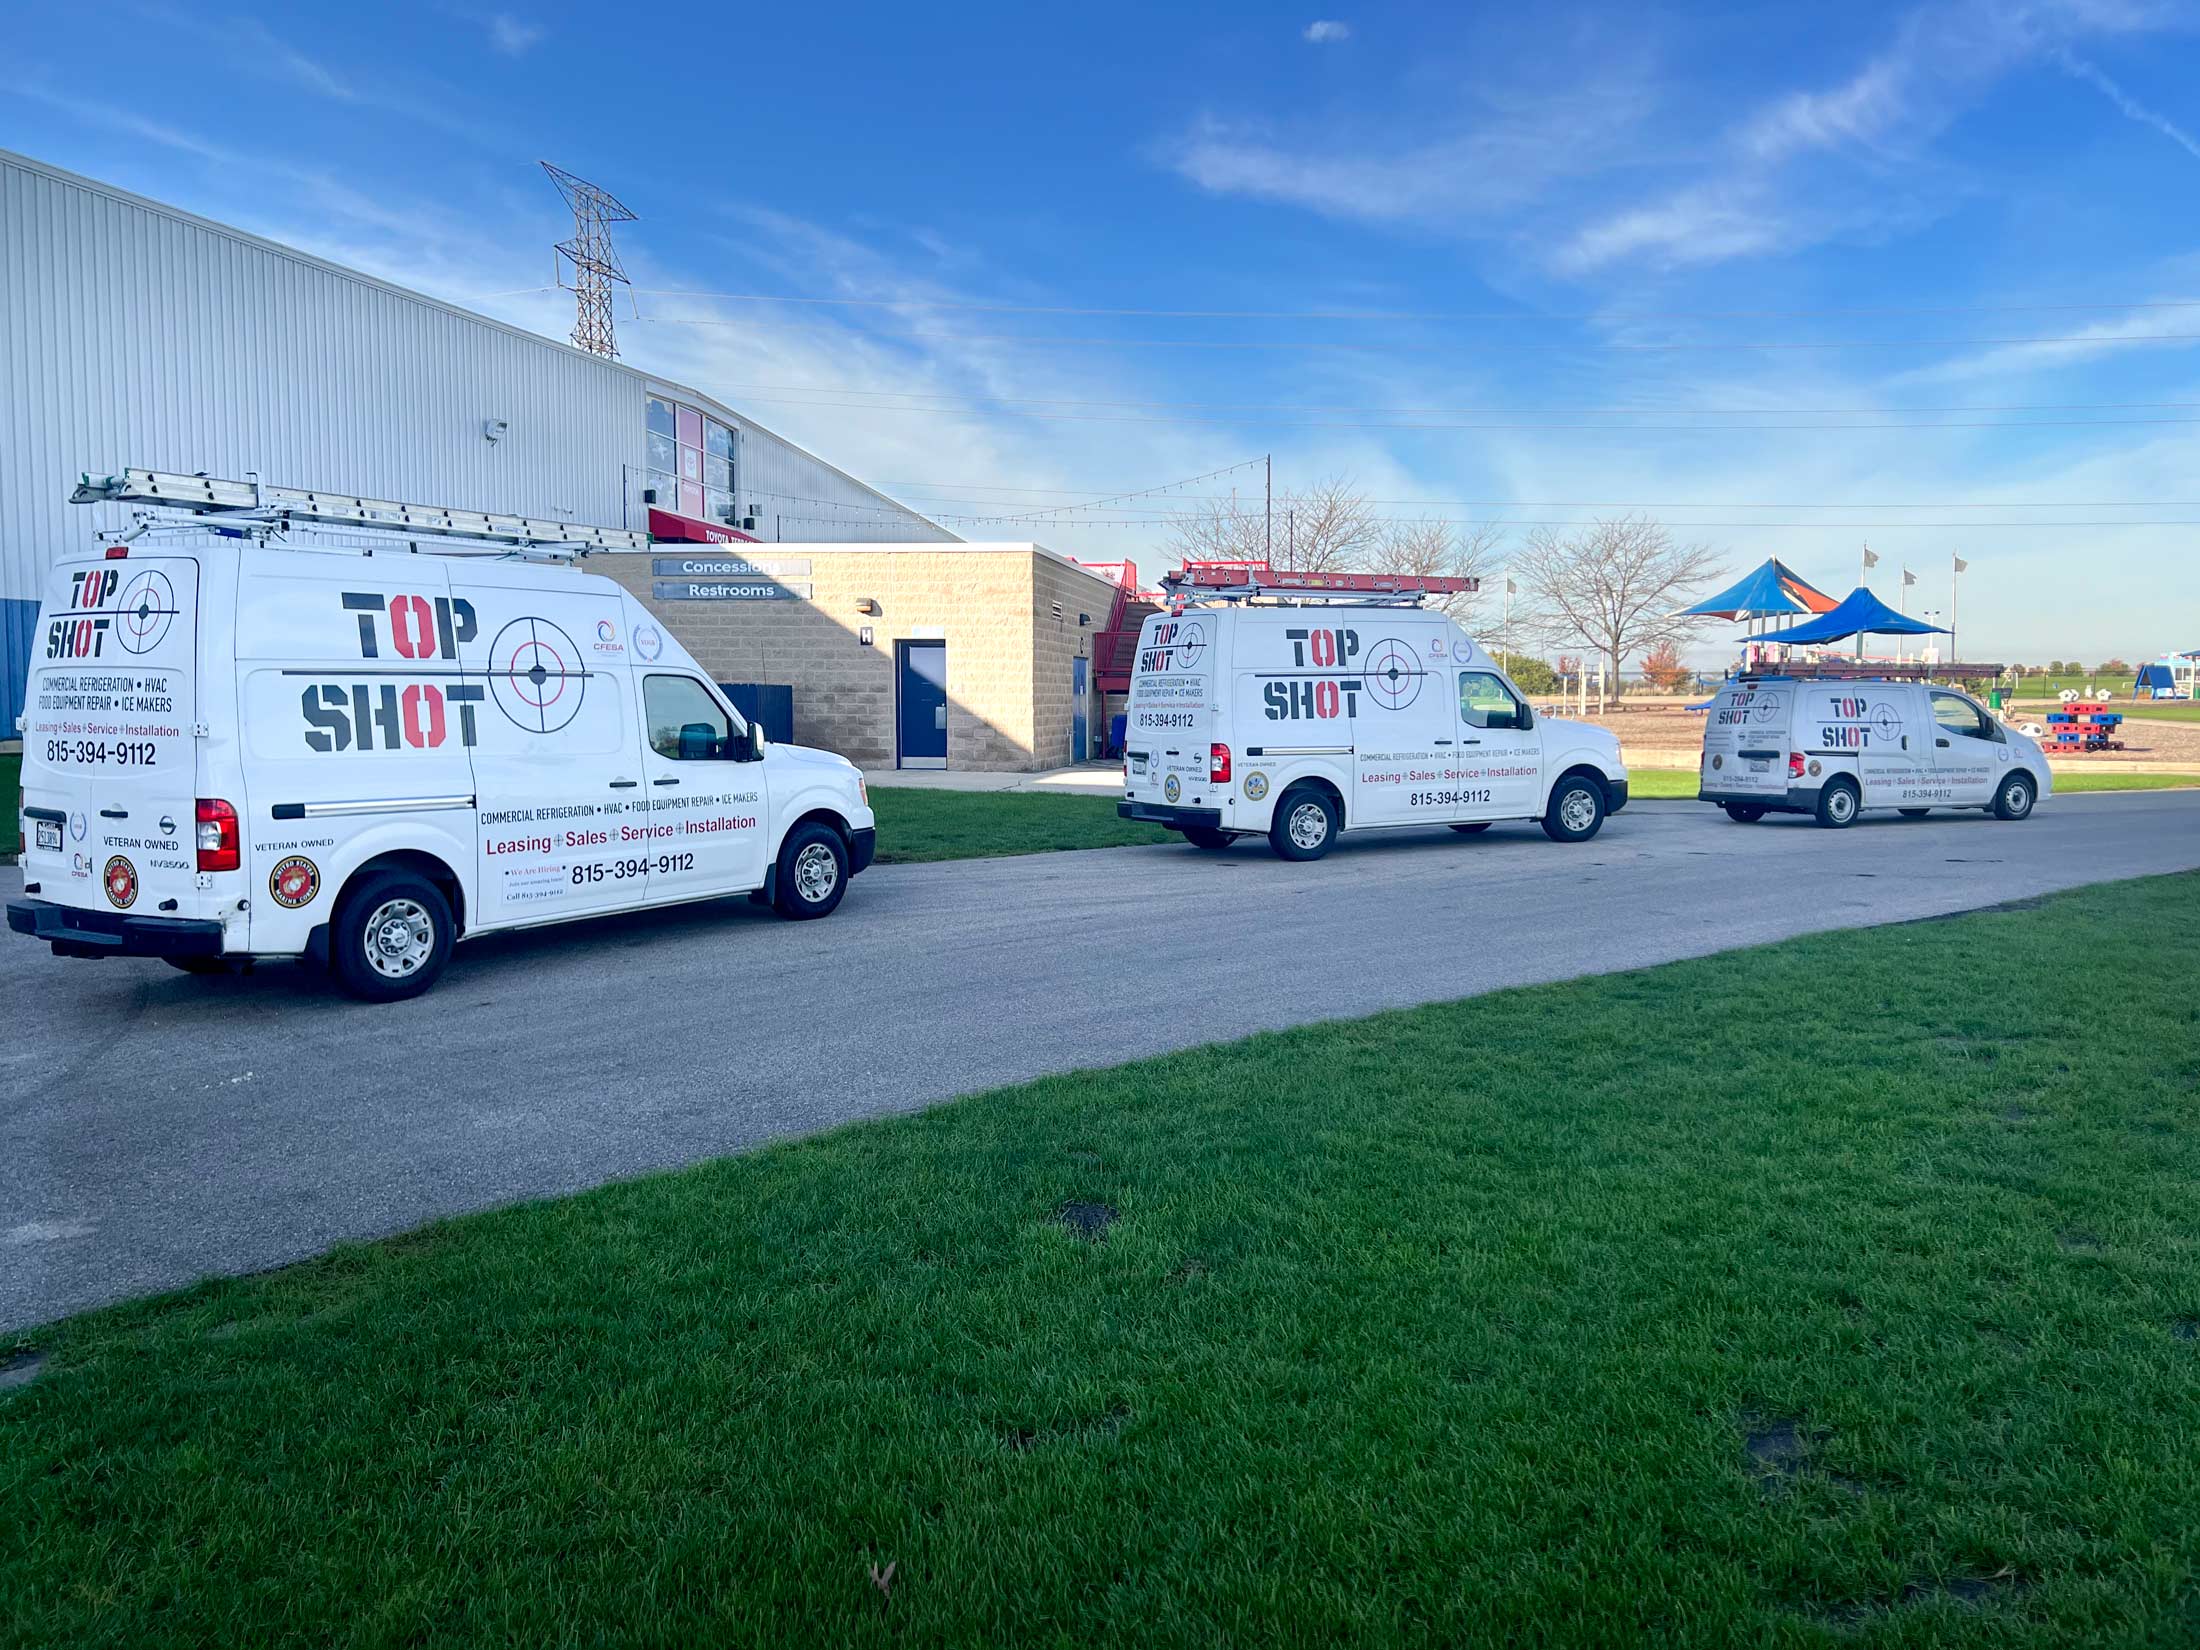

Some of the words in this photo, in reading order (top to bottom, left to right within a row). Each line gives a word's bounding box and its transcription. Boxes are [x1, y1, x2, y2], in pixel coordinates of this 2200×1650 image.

[705, 530, 729, 543] TOYOTA
[682, 560, 780, 573] Concessions
[71, 569, 119, 608] TOP
[689, 584, 775, 596] Restrooms
[340, 591, 479, 660] TOP
[1153, 623, 1179, 645] TOP
[47, 619, 110, 659] SHOT
[861, 629, 872, 643] H
[1285, 629, 1359, 667] TOP
[1140, 650, 1173, 672] SHOT
[43, 677, 78, 692] COMMERCIAL
[79, 677, 134, 692] REFRIGERATION
[144, 678, 167, 693] HVAC
[53, 695, 86, 711] EQUIPMENT
[86, 695, 112, 711] REPAIR
[121, 696, 134, 711] ICE
[136, 697, 172, 712] MAKERS
[1264, 681, 1362, 720] SHOT
[1731, 692, 1755, 706] TOP
[1830, 698, 1867, 718] TOP
[301, 684, 485, 752] SHOT
[1140, 713, 1194, 727] 815-394-9112
[1718, 710, 1750, 724] SHOT
[62, 722, 81, 734] Sales
[87, 722, 118, 735] Service
[125, 724, 179, 737] Installation
[1822, 727, 1871, 747] SHOT
[47, 740, 156, 765] 815-394-9112
[1362, 772, 1401, 784] Leasing
[1409, 770, 1436, 781] Sales
[1444, 768, 1479, 779] Service
[1487, 766, 1538, 777] Installation
[1411, 789, 1491, 806] 815-394-9112
[1902, 788, 1952, 798] 815-394-9112
[481, 809, 535, 825] COMMERCIAL
[536, 805, 595, 821] REFRIGERATION
[603, 802, 623, 815] HVAC
[632, 800, 651, 812] FOOD
[652, 797, 690, 811] EQUIPMENT
[691, 795, 714, 808] REPAIR
[721, 793, 731, 804] ICE
[732, 792, 758, 803] MAKERS
[103, 836, 140, 849] VETERAN
[144, 839, 179, 851] OWNED
[486, 835, 551, 855] Leasing
[565, 830, 607, 847] Sales
[621, 823, 674, 841] Service
[685, 816, 756, 835] Installation
[255, 841, 298, 852] VETERAN
[300, 838, 334, 848] OWNED
[571, 853, 694, 884] 815-394-9112
